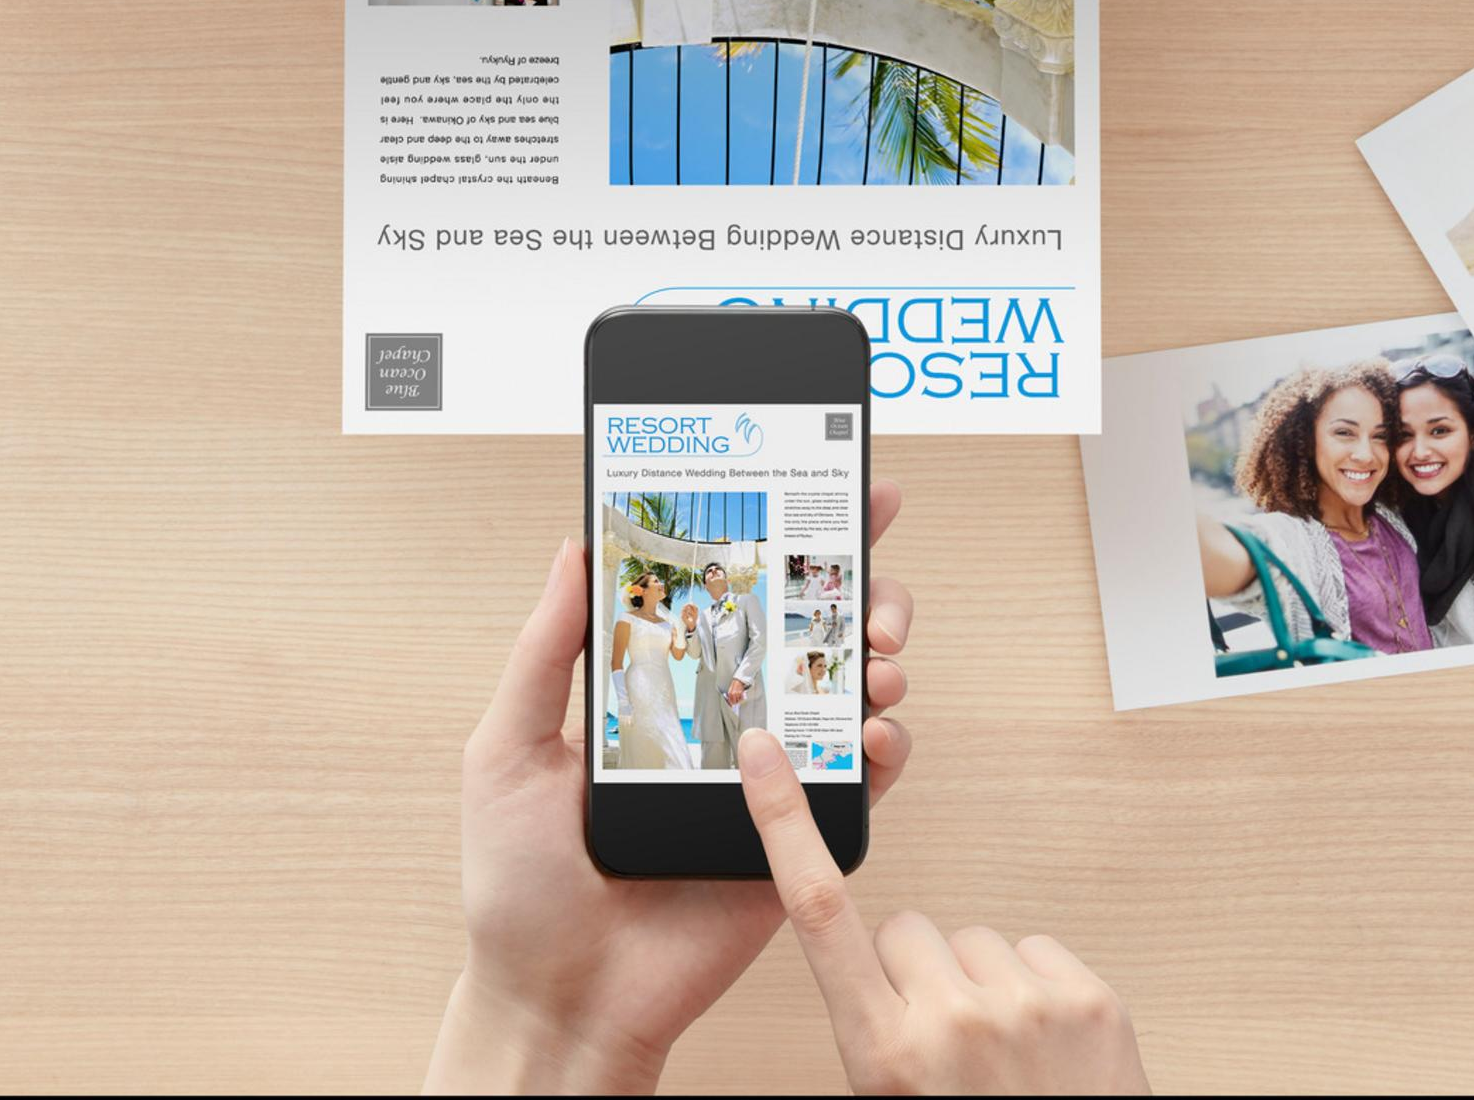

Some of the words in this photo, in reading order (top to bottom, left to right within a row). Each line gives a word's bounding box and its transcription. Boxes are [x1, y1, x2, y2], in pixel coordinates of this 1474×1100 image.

[479, 55, 515, 65] Ryukyu.
[517, 57, 527, 65] of
[529, 57, 559, 65] breeze
[380, 75, 410, 85] gentle
[413, 76, 431, 85] and
[434, 75, 450, 85] sky
[494, 75, 505, 85] by
[509, 76, 559, 85] celebrated
[381, 96, 400, 105] feel
[404, 95, 423, 103] you
[427, 96, 458, 105] where
[463, 95, 491, 105] place
[496, 96, 512, 105] the
[517, 95, 539, 105] only
[543, 96, 559, 105] the
[380, 116, 388, 124] is
[391, 116, 413, 125] Here
[420, 116, 464, 125] Okinawa.
[466, 116, 476, 125] of
[479, 115, 495, 124] sky
[498, 116, 516, 124] and
[538, 116, 559, 124] blue
[380, 136, 404, 144] clear
[407, 136, 425, 144] and
[428, 134, 452, 144] deep
[455, 136, 470, 144] the
[473, 136, 483, 144] to
[486, 134, 511, 143] away
[514, 136, 559, 144] stretches
[380, 156, 404, 164] aisle
[408, 154, 451, 164] wedding
[455, 154, 481, 164] glass
[510, 156, 526, 164] the
[530, 156, 559, 164] under
[380, 174, 417, 184] shining
[421, 174, 455, 184] chapel
[458, 174, 493, 184] crystal
[497, 176, 513, 184] the
[517, 176, 559, 185] Beneath
[378, 224, 425, 250] Sky
[437, 230, 483, 250] and
[494, 230, 542, 250] Sea
[553, 230, 593, 250] the
[605, 230, 714, 250] Between
[728, 224, 840, 250] Wedding
[851, 230, 963, 250] Distance
[975, 224, 1061, 250] Luxury
[375, 345, 431, 364] Chapel
[378, 367, 426, 381] Ocean
[384, 384, 420, 398] Blue
[608, 417, 712, 434] RESORT
[607, 436, 730, 453] WEDDING
[606, 468, 638, 479] Luxury
[641, 468, 682, 478] Distance
[685, 468, 726, 479] Wedding
[729, 468, 769, 478] Between
[772, 468, 787, 478] the
[790, 468, 808, 478] Sea
[811, 468, 828, 478] and
[831, 468, 850, 479] Sky
